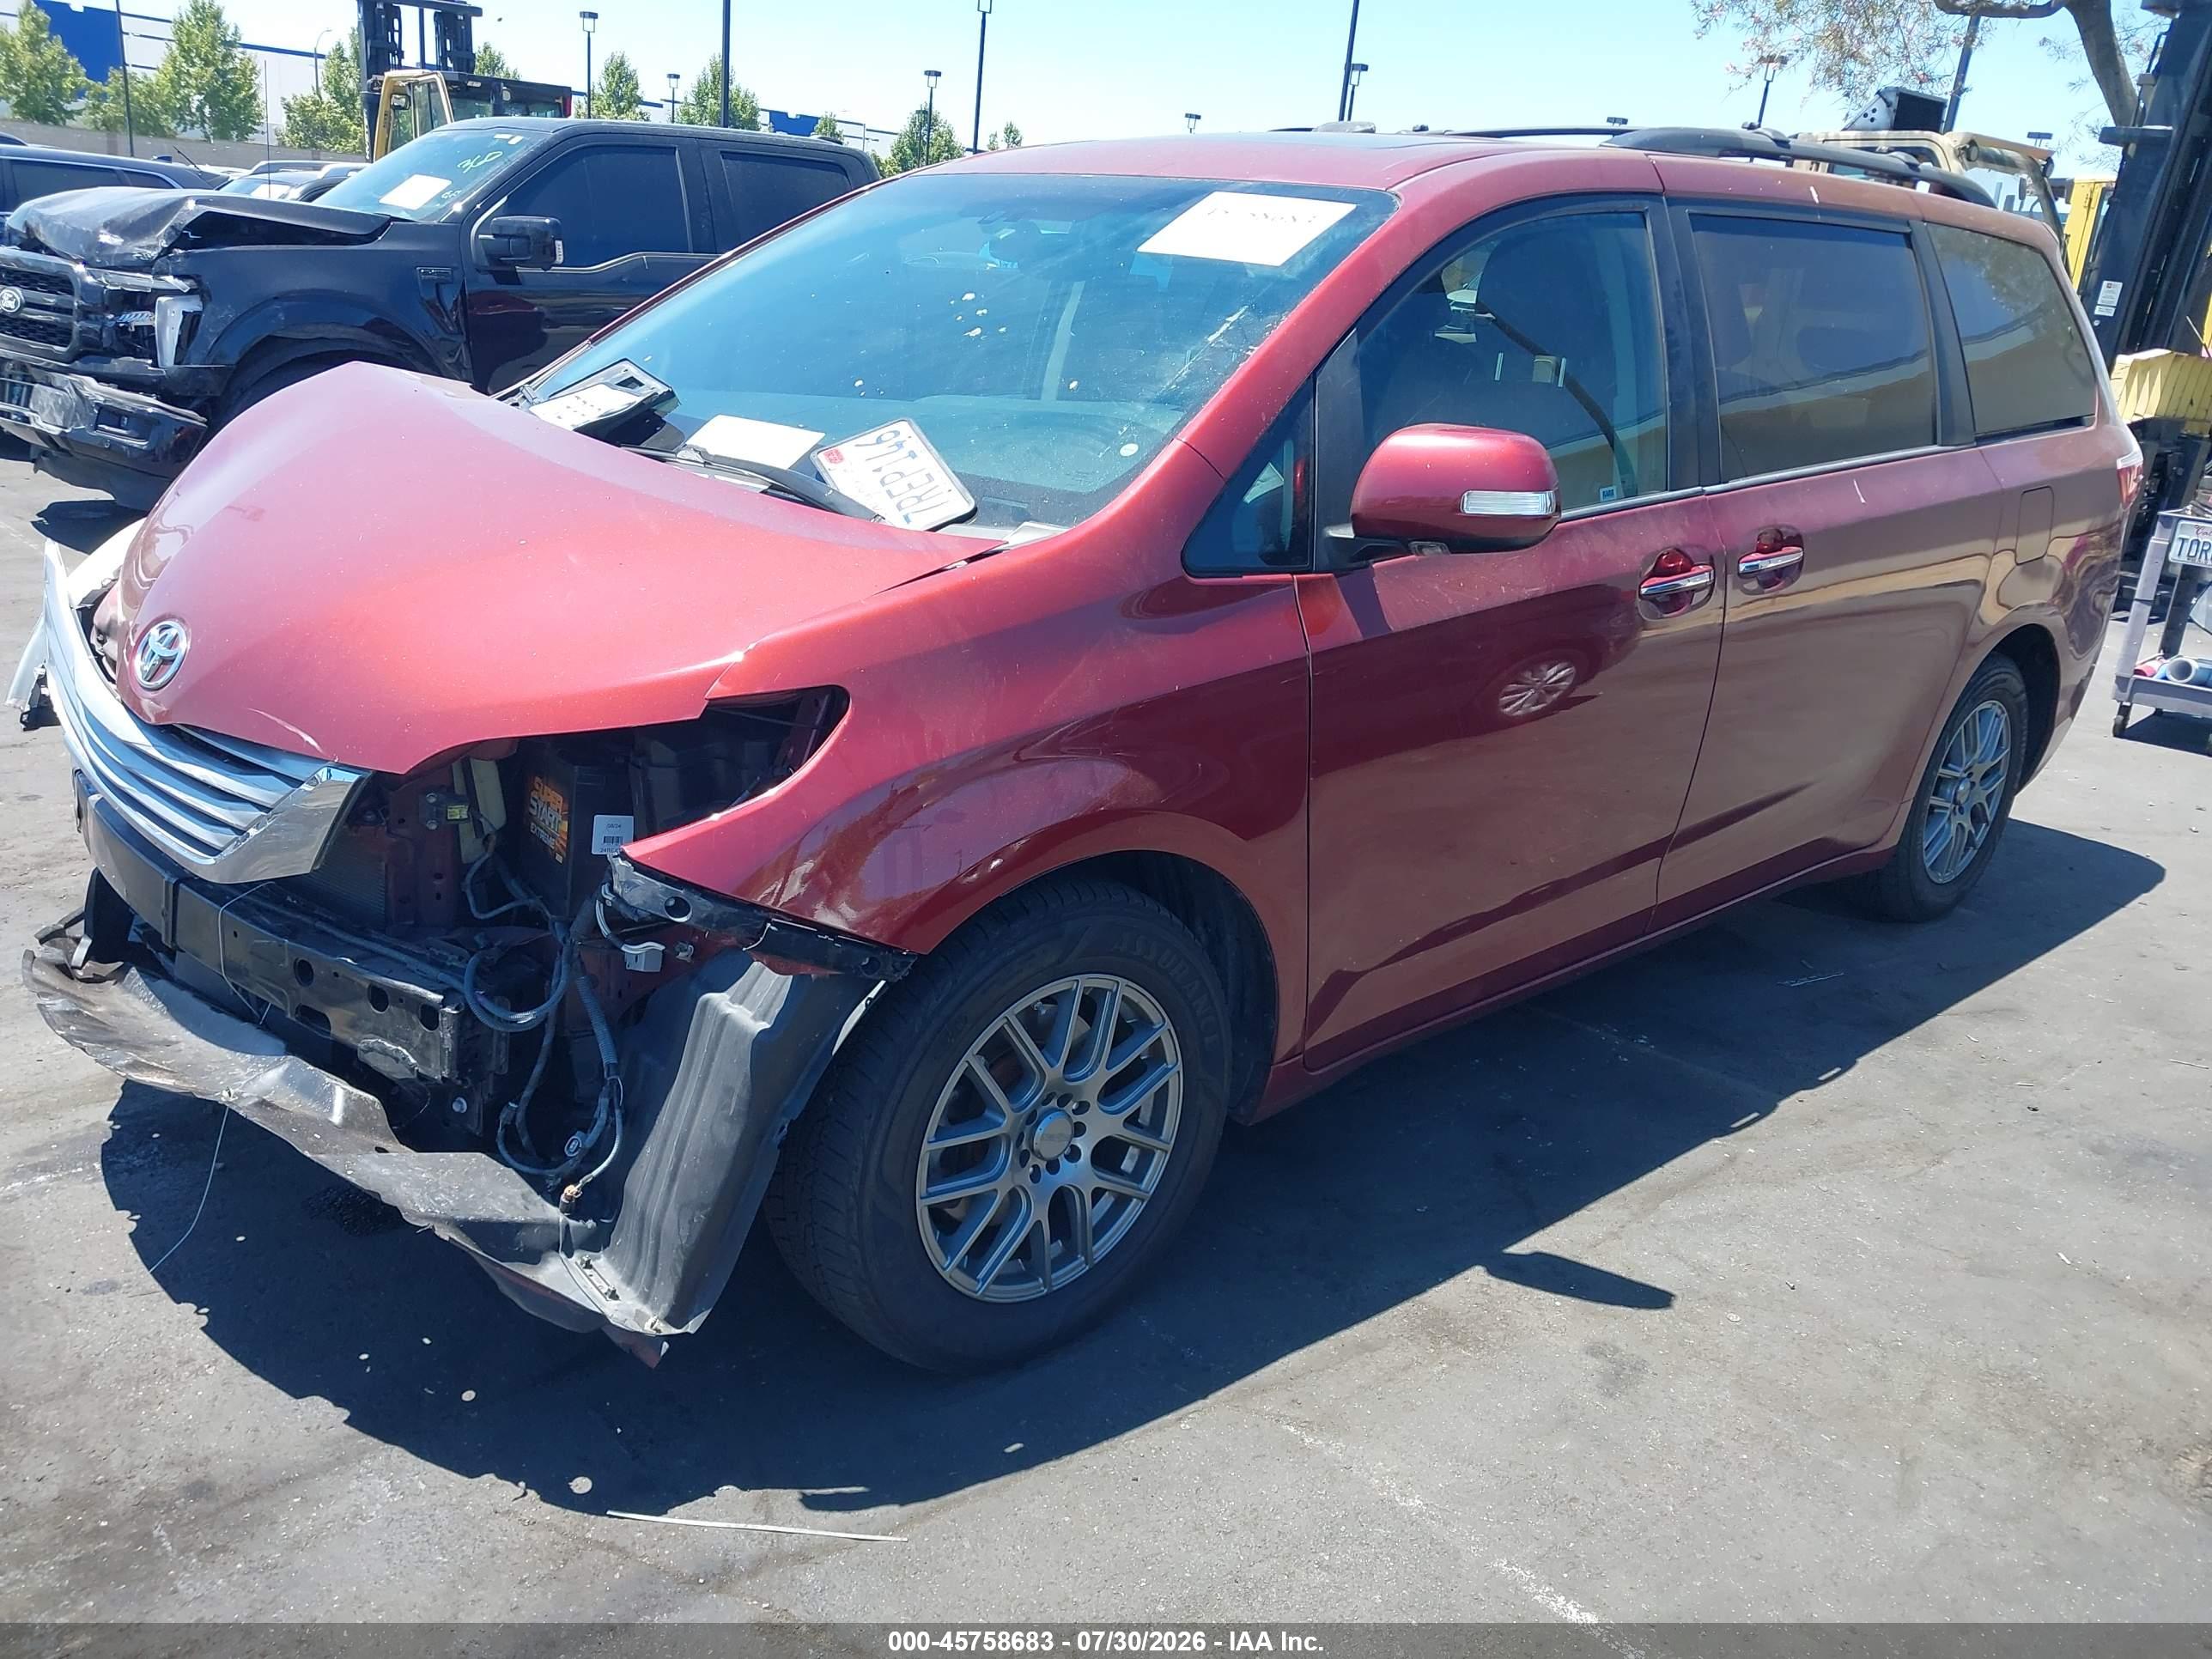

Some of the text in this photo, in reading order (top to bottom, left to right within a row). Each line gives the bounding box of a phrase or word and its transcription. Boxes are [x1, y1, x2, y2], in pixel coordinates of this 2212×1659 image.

[854, 429, 950, 525] 7REP146
[2178, 537, 2212, 561] TOR
[529, 796, 562, 832] START
